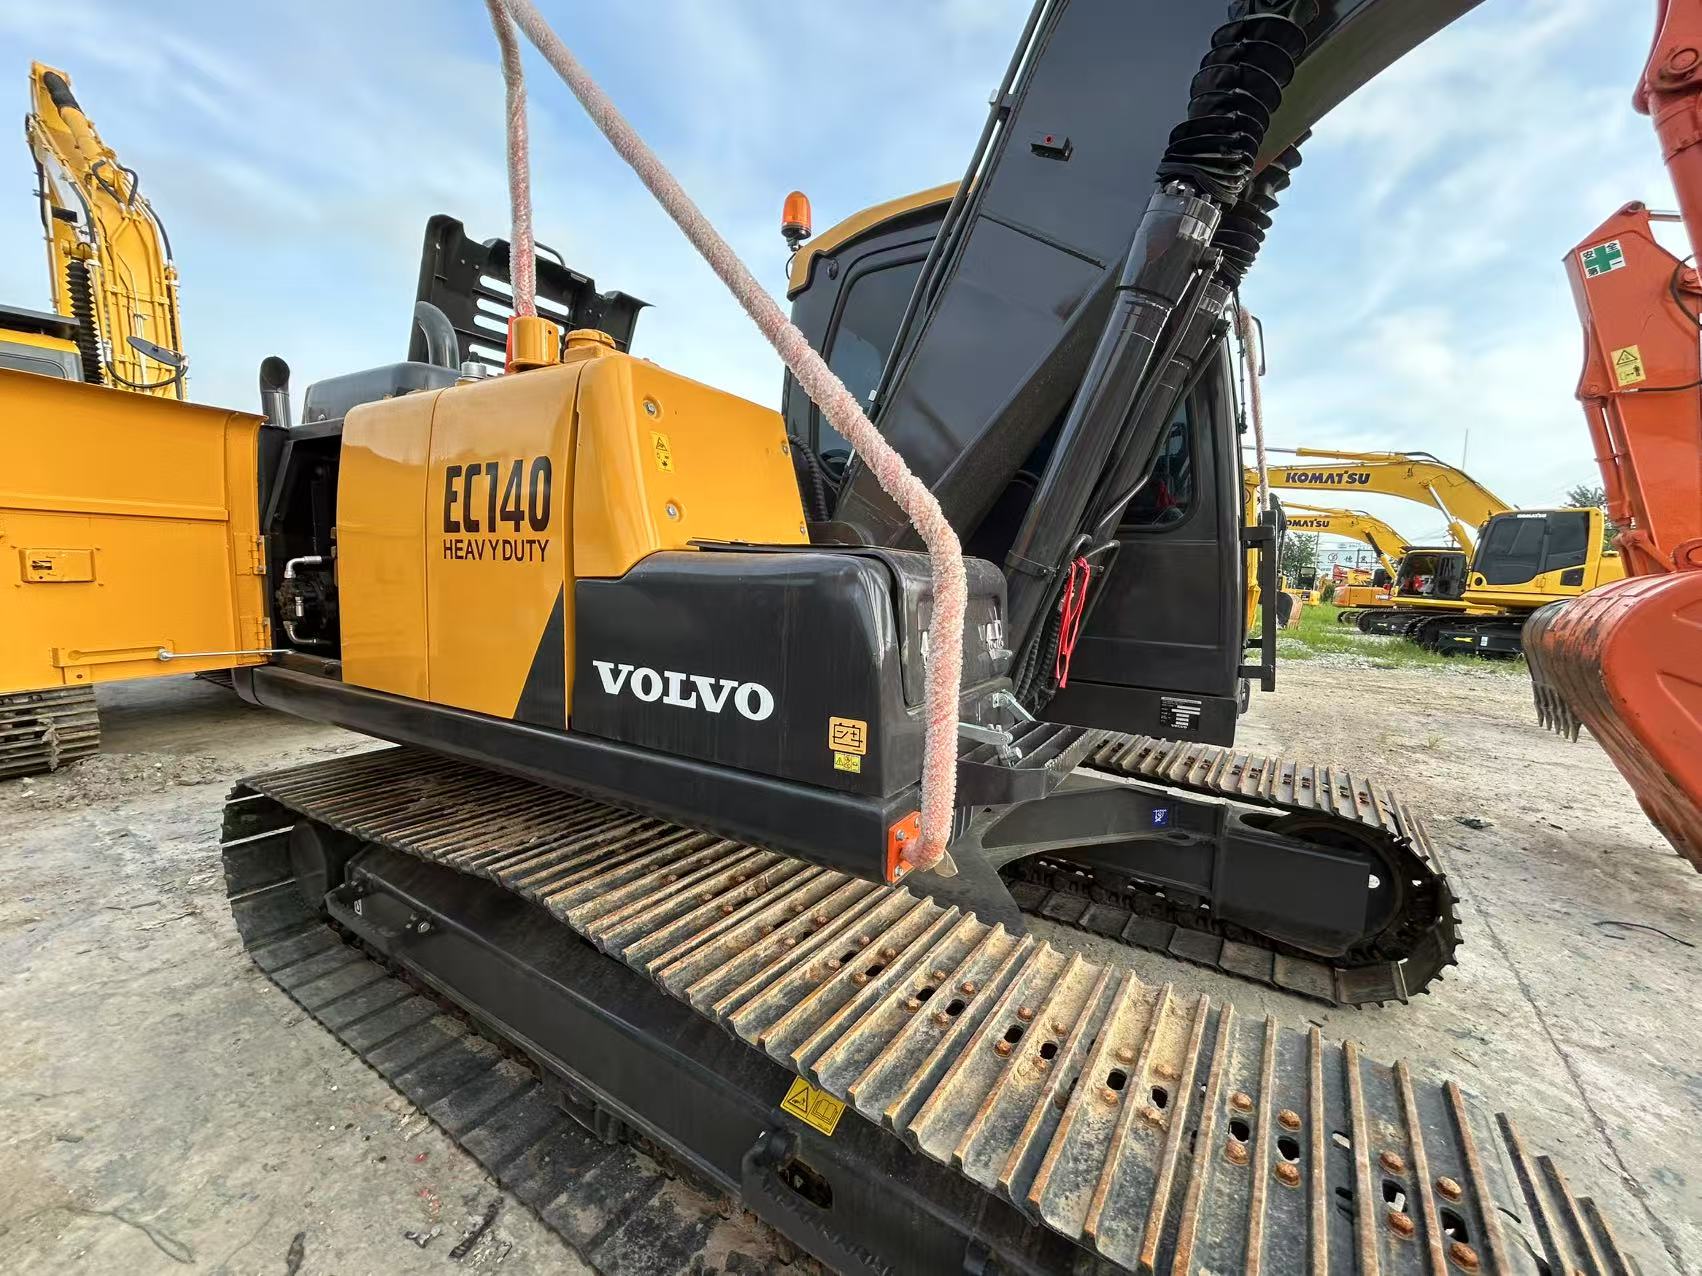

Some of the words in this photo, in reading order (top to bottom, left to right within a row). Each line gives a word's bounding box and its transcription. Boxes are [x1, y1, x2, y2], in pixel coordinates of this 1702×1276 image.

[443, 456, 552, 533] EC140
[1285, 470, 1370, 484] KOMATSU
[1286, 519, 1330, 528] OMATSU
[592, 660, 775, 721] VOLVO
